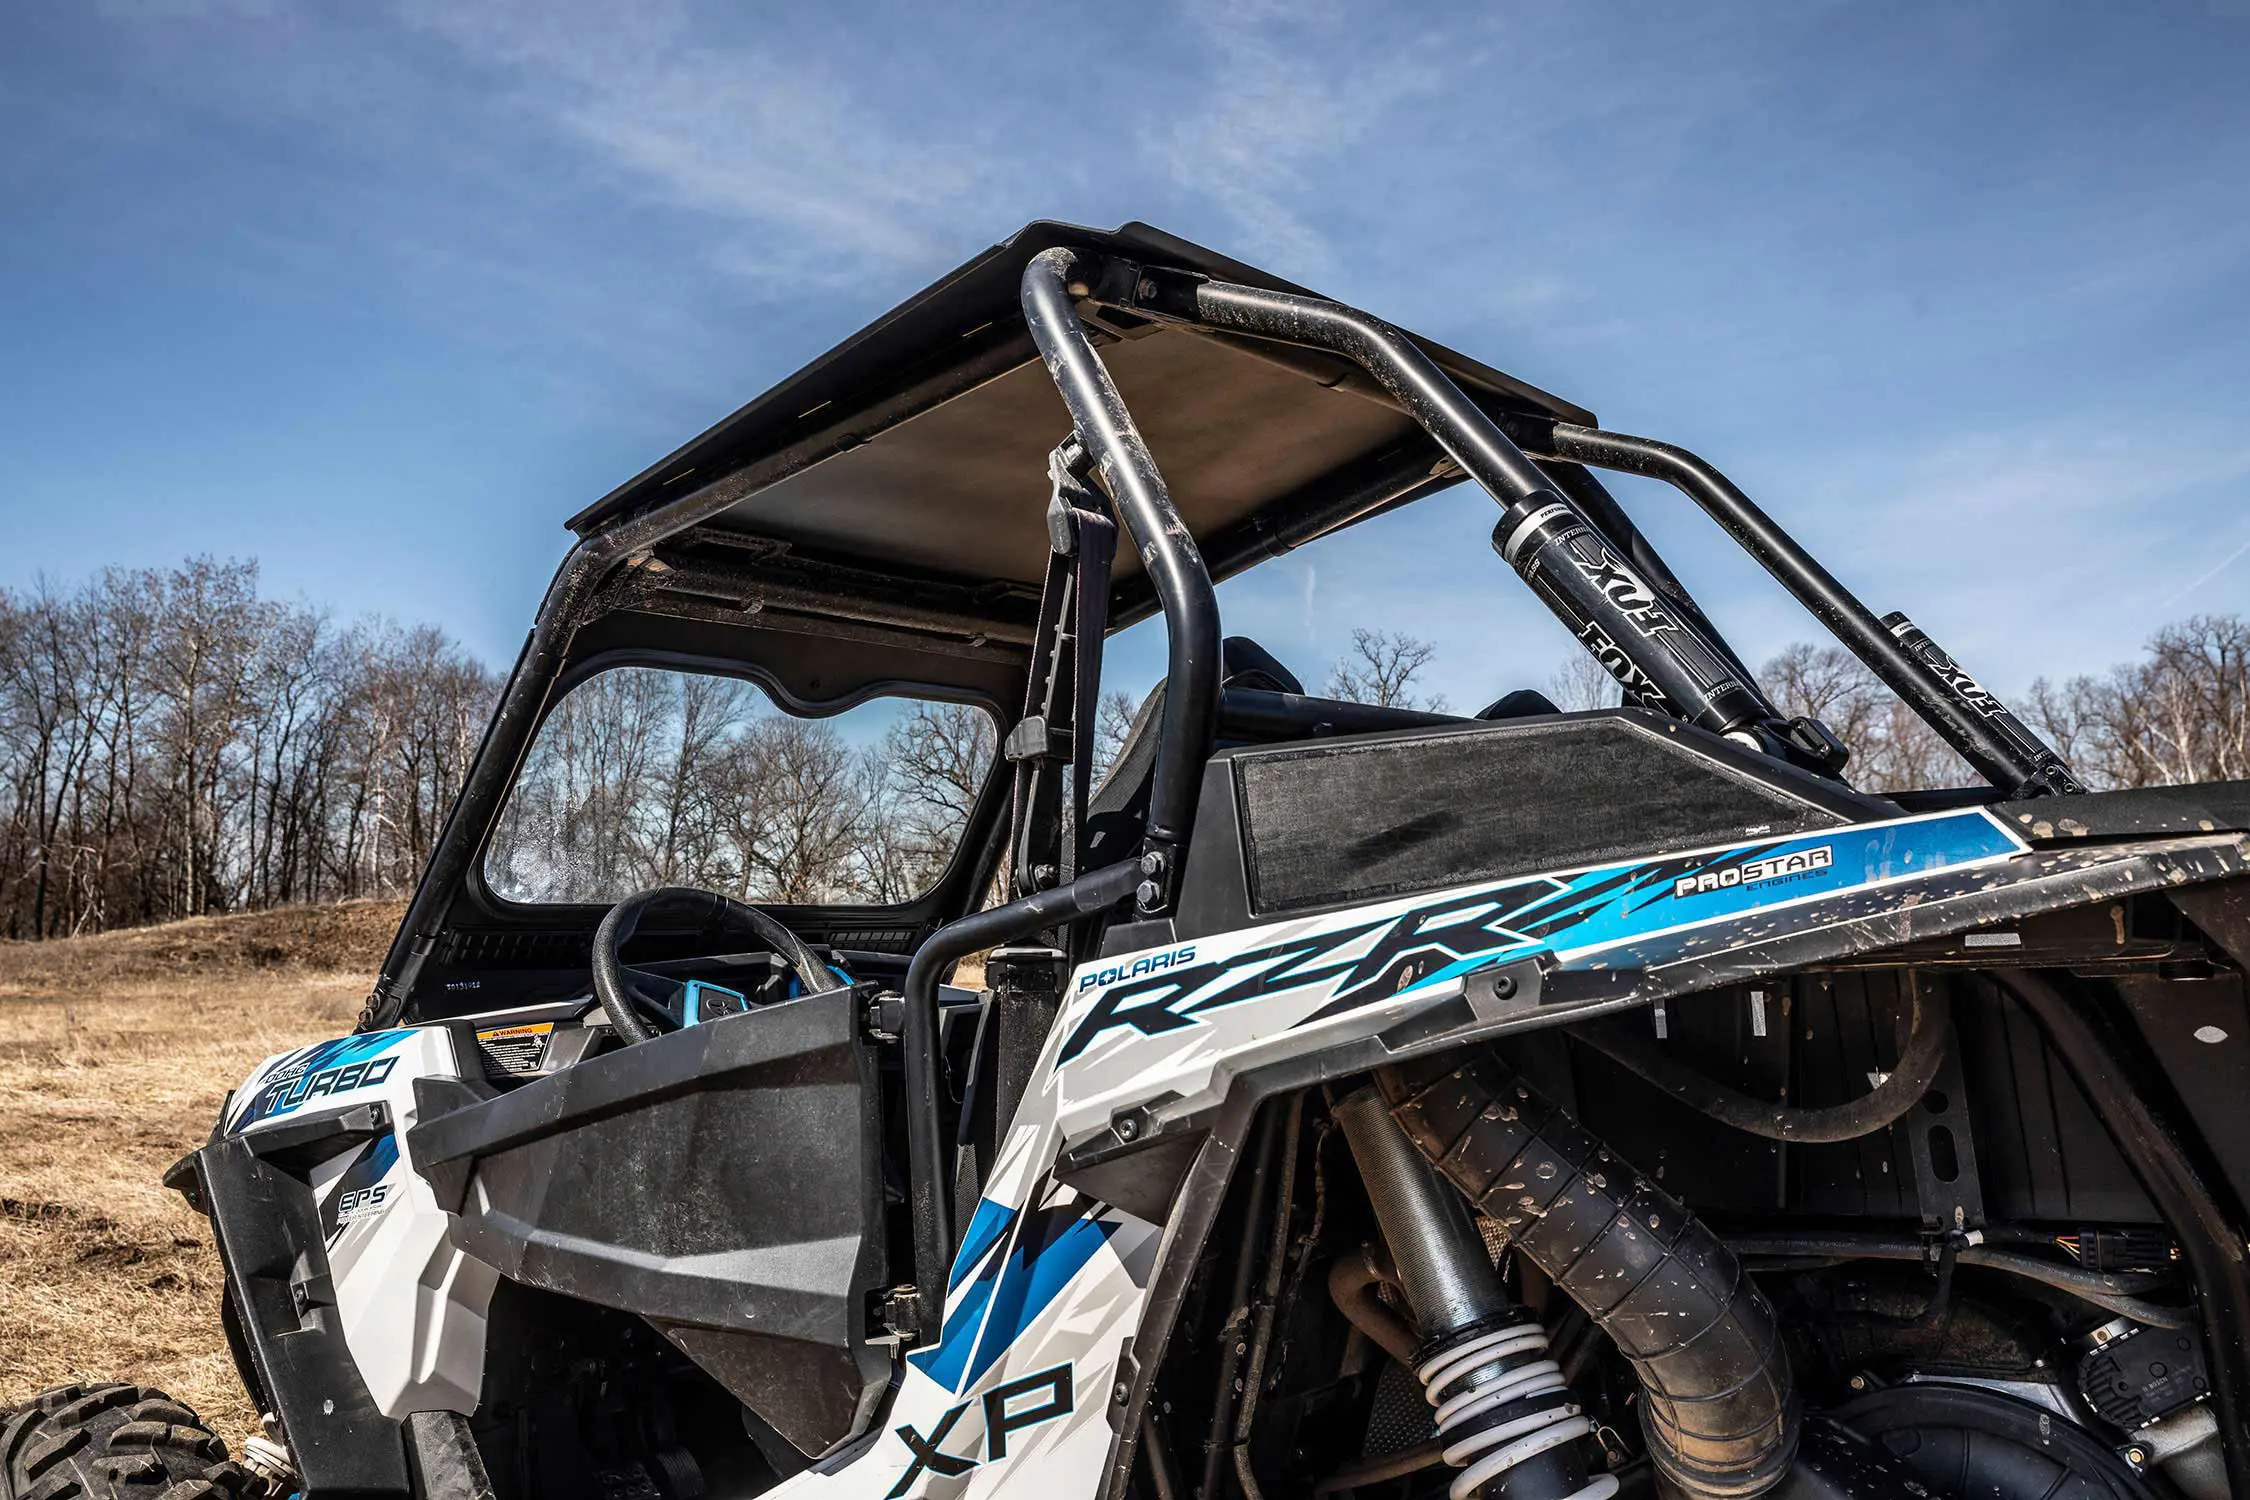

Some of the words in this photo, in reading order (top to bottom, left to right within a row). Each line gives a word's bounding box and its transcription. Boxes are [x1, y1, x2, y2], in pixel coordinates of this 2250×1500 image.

[1575, 547, 1680, 638] FOX
[1577, 620, 1667, 711] FOX
[1927, 655, 2008, 718] FOX
[1676, 848, 1831, 897] PROSTAR
[1746, 869, 1827, 892] ENGINES
[1054, 878, 1568, 1074] RZR
[1079, 945, 1197, 993] POLARIS
[499, 1028, 533, 1037] WARNING
[265, 1056, 400, 1114] TURBO
[339, 1184, 388, 1212] EPS
[884, 1360, 1074, 1500] XP
